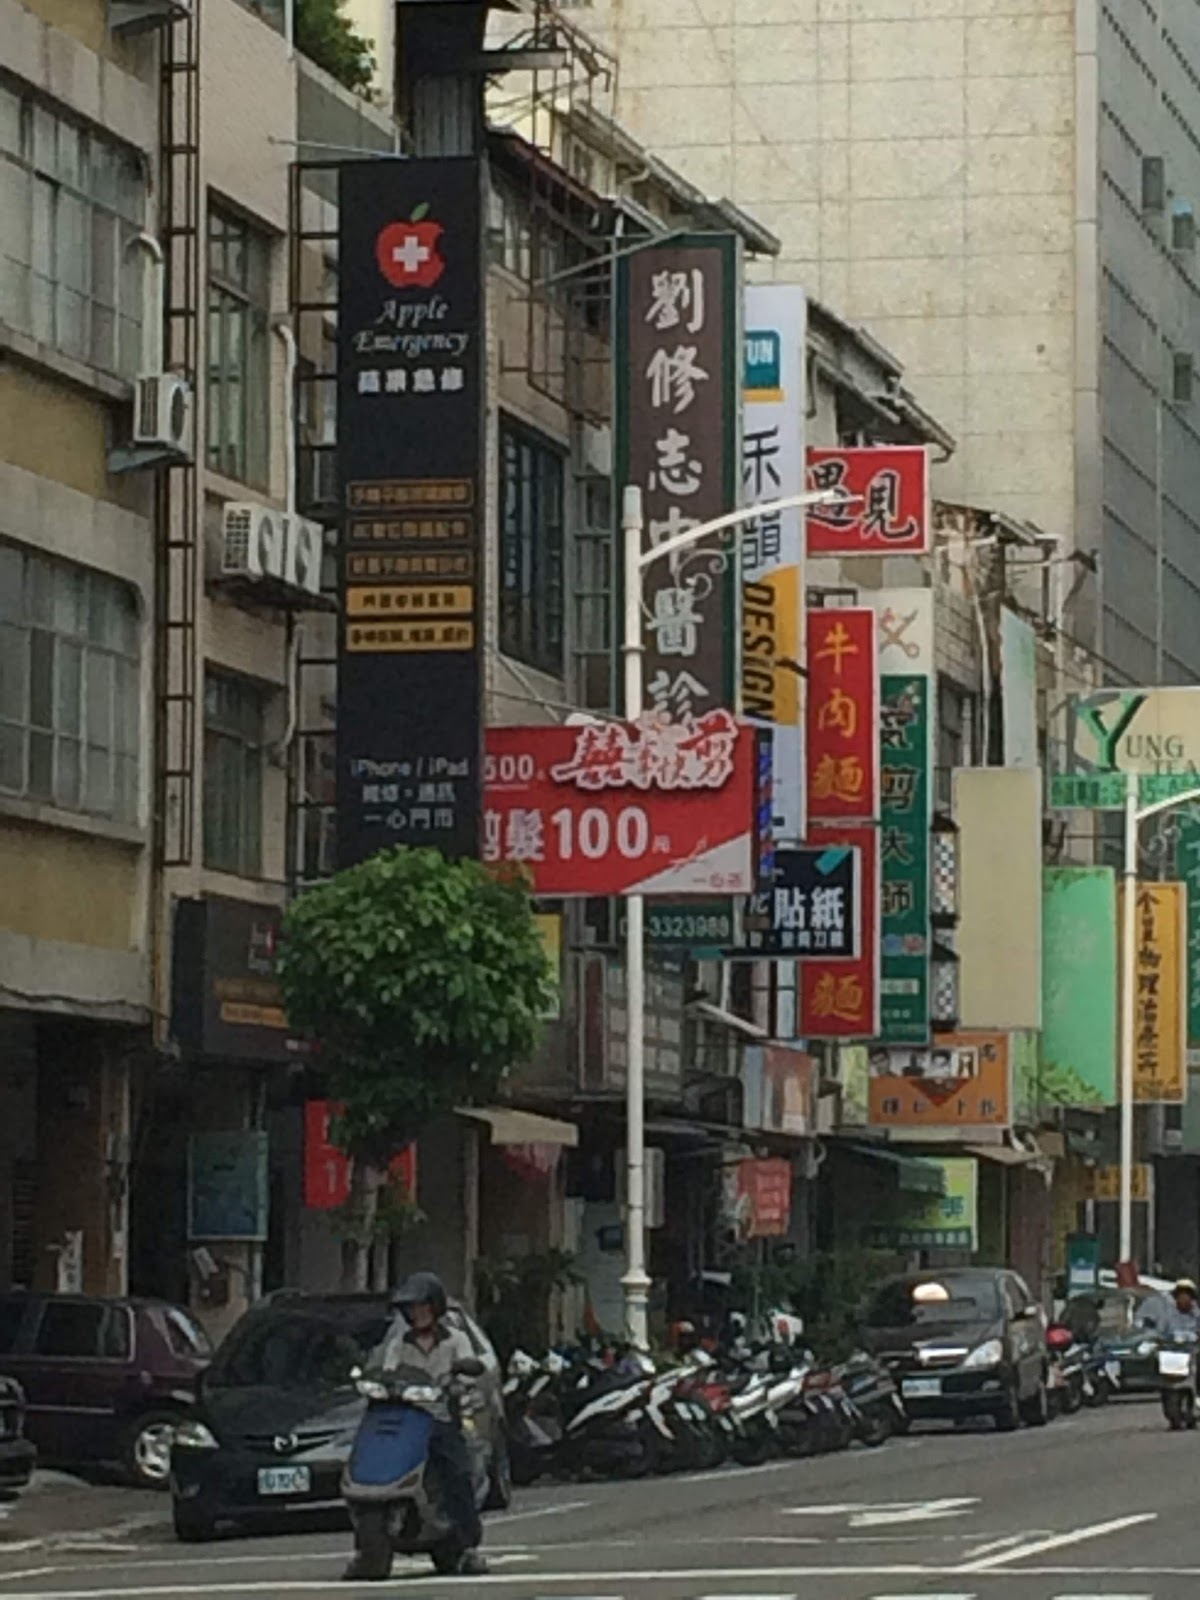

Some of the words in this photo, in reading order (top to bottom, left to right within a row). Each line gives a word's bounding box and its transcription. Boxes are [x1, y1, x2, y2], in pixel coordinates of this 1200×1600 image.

[376, 297, 449, 328] Apple
[353, 331, 470, 357] Emergency
[743, 580, 776, 722] DESIGN
[775, 887, 845, 930] 貼紙
